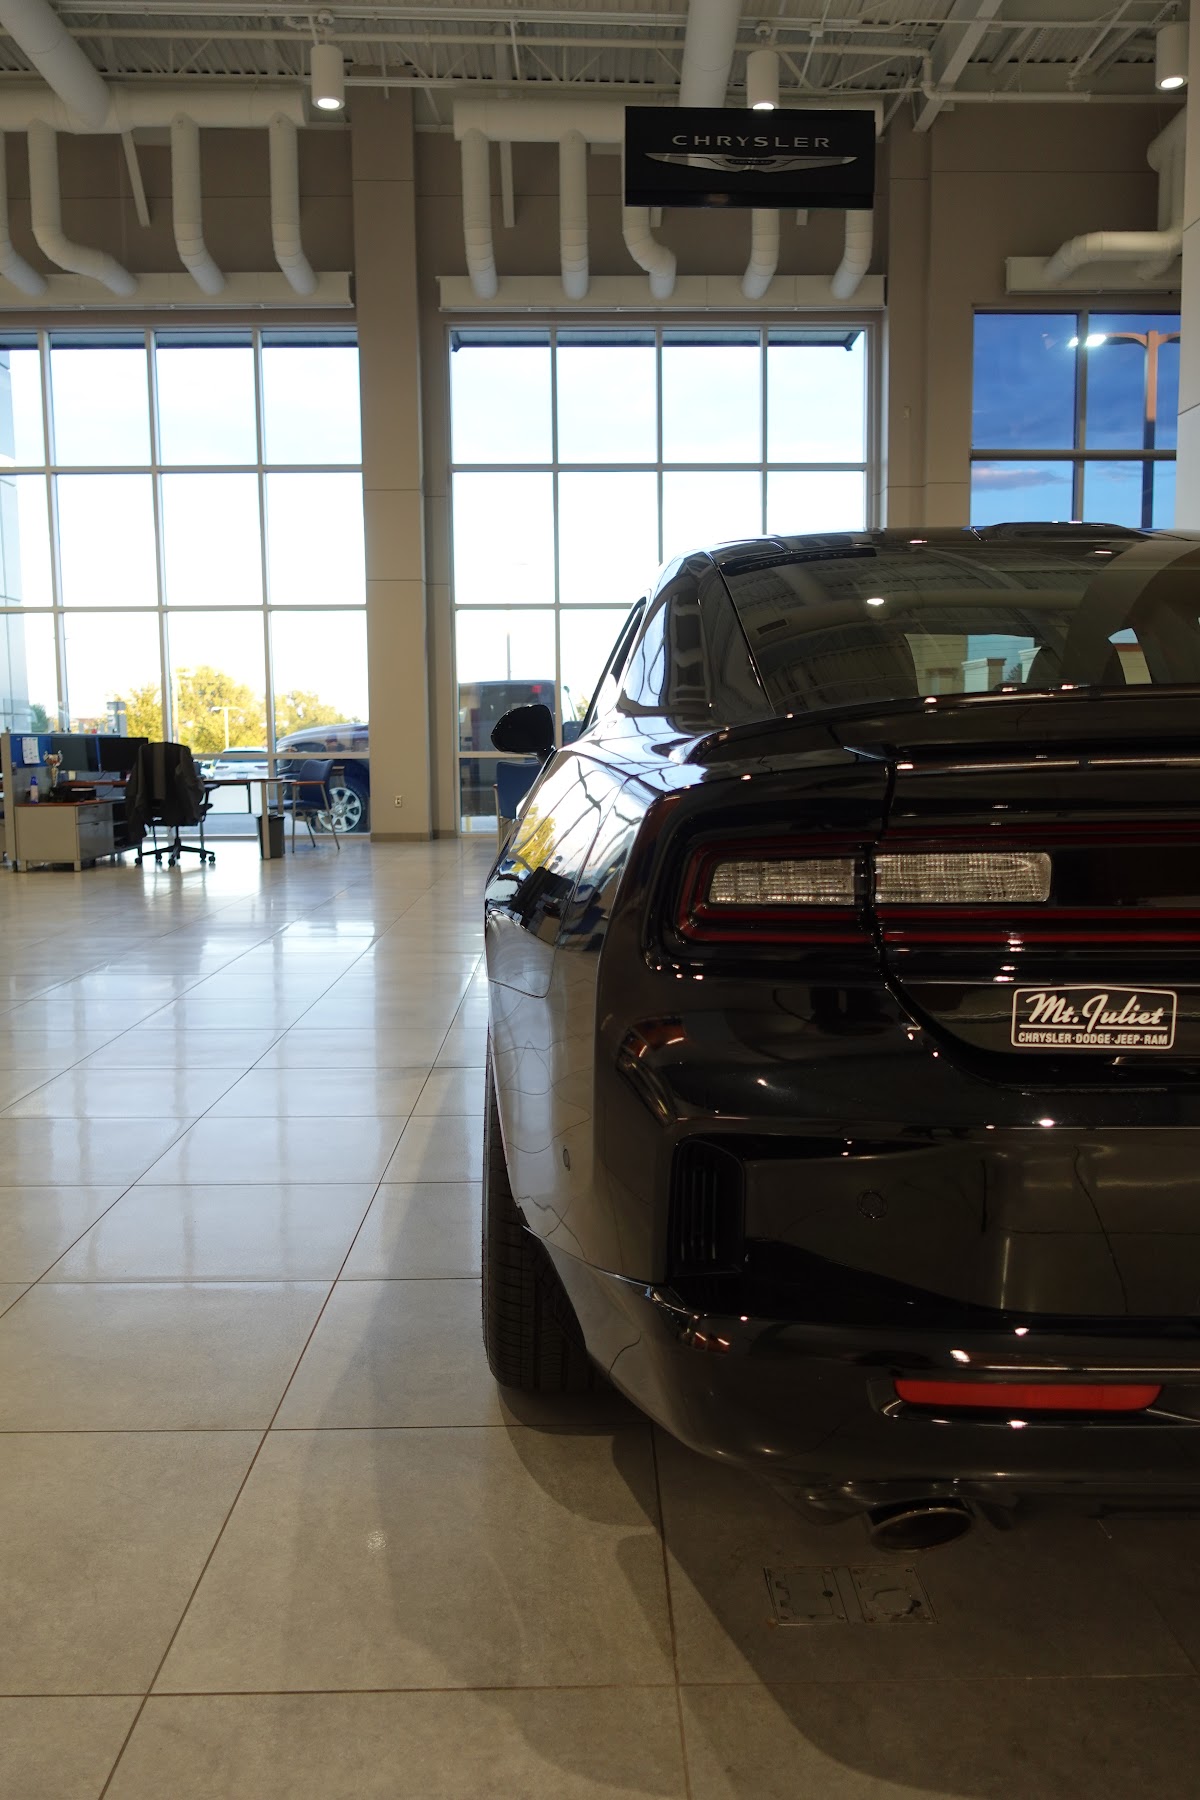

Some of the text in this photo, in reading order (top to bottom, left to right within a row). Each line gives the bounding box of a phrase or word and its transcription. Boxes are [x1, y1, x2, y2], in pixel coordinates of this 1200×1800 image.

[672, 135, 830, 148] CHRYSLER
[1026, 993, 1164, 1033] Mt. Juliet
[1018, 1032, 1168, 1045] CHRYSLER DODGE JEEP RAM
